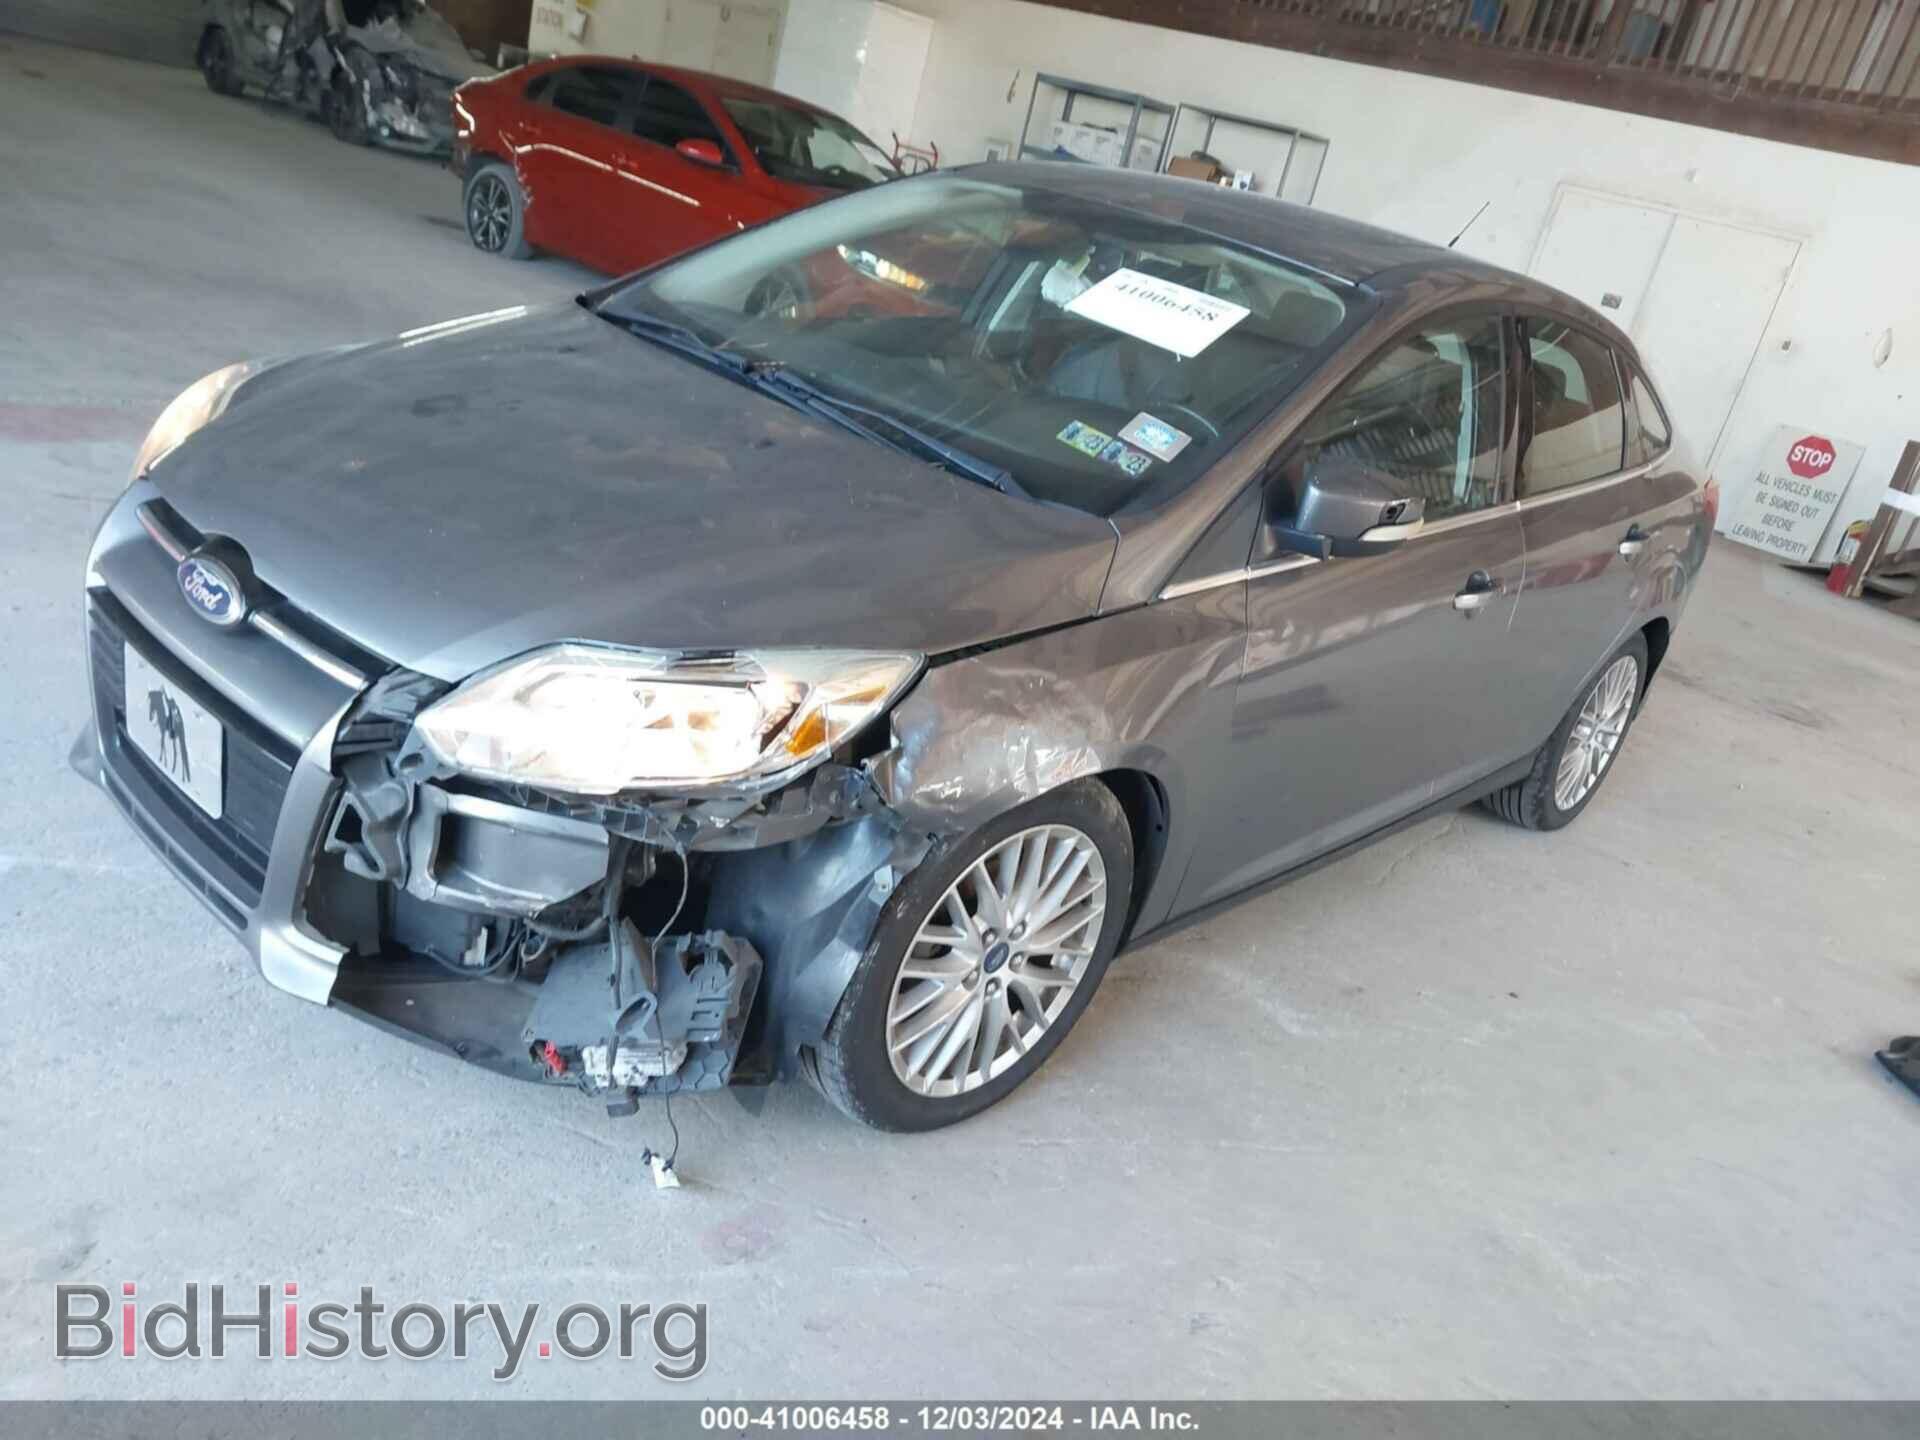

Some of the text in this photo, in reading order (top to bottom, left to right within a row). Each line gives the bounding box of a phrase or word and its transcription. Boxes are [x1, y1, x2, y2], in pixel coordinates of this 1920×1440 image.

[1791, 445, 1833, 468] STOP
[1754, 471, 1838, 505] ALL VEHICLES MUST
[1755, 491, 1820, 519] BE SIGNED OUT
[1761, 512, 1796, 532] BEFORE
[1731, 522, 1808, 554] LEAVING PROPERTY
[184, 568, 223, 611] Ford
